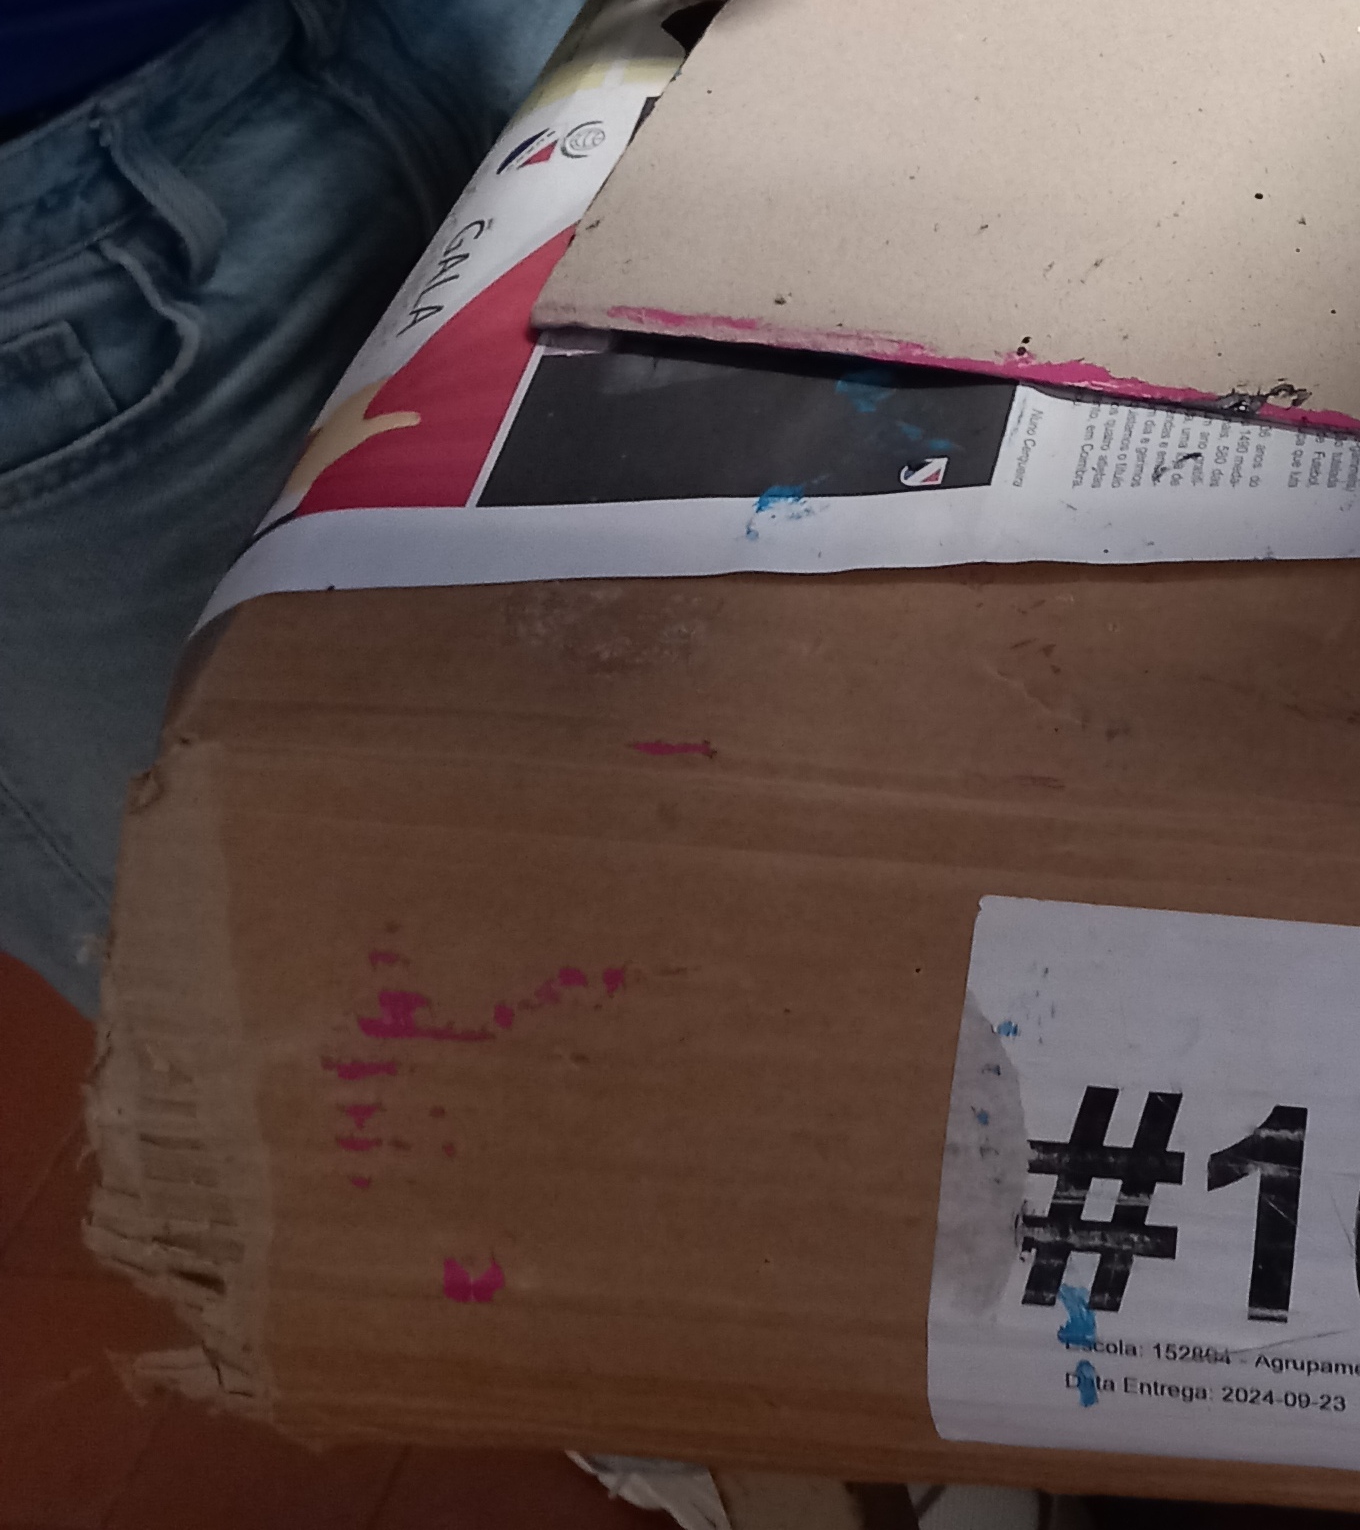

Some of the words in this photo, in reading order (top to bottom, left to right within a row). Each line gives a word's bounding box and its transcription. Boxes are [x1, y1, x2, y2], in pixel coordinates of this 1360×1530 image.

[396, 220, 485, 337] GALA
[1066, 1372, 1115, 1394] Dta
[1124, 1377, 1212, 1403] Entrega:
[1221, 1386, 1346, 1412] 2024-09-23
